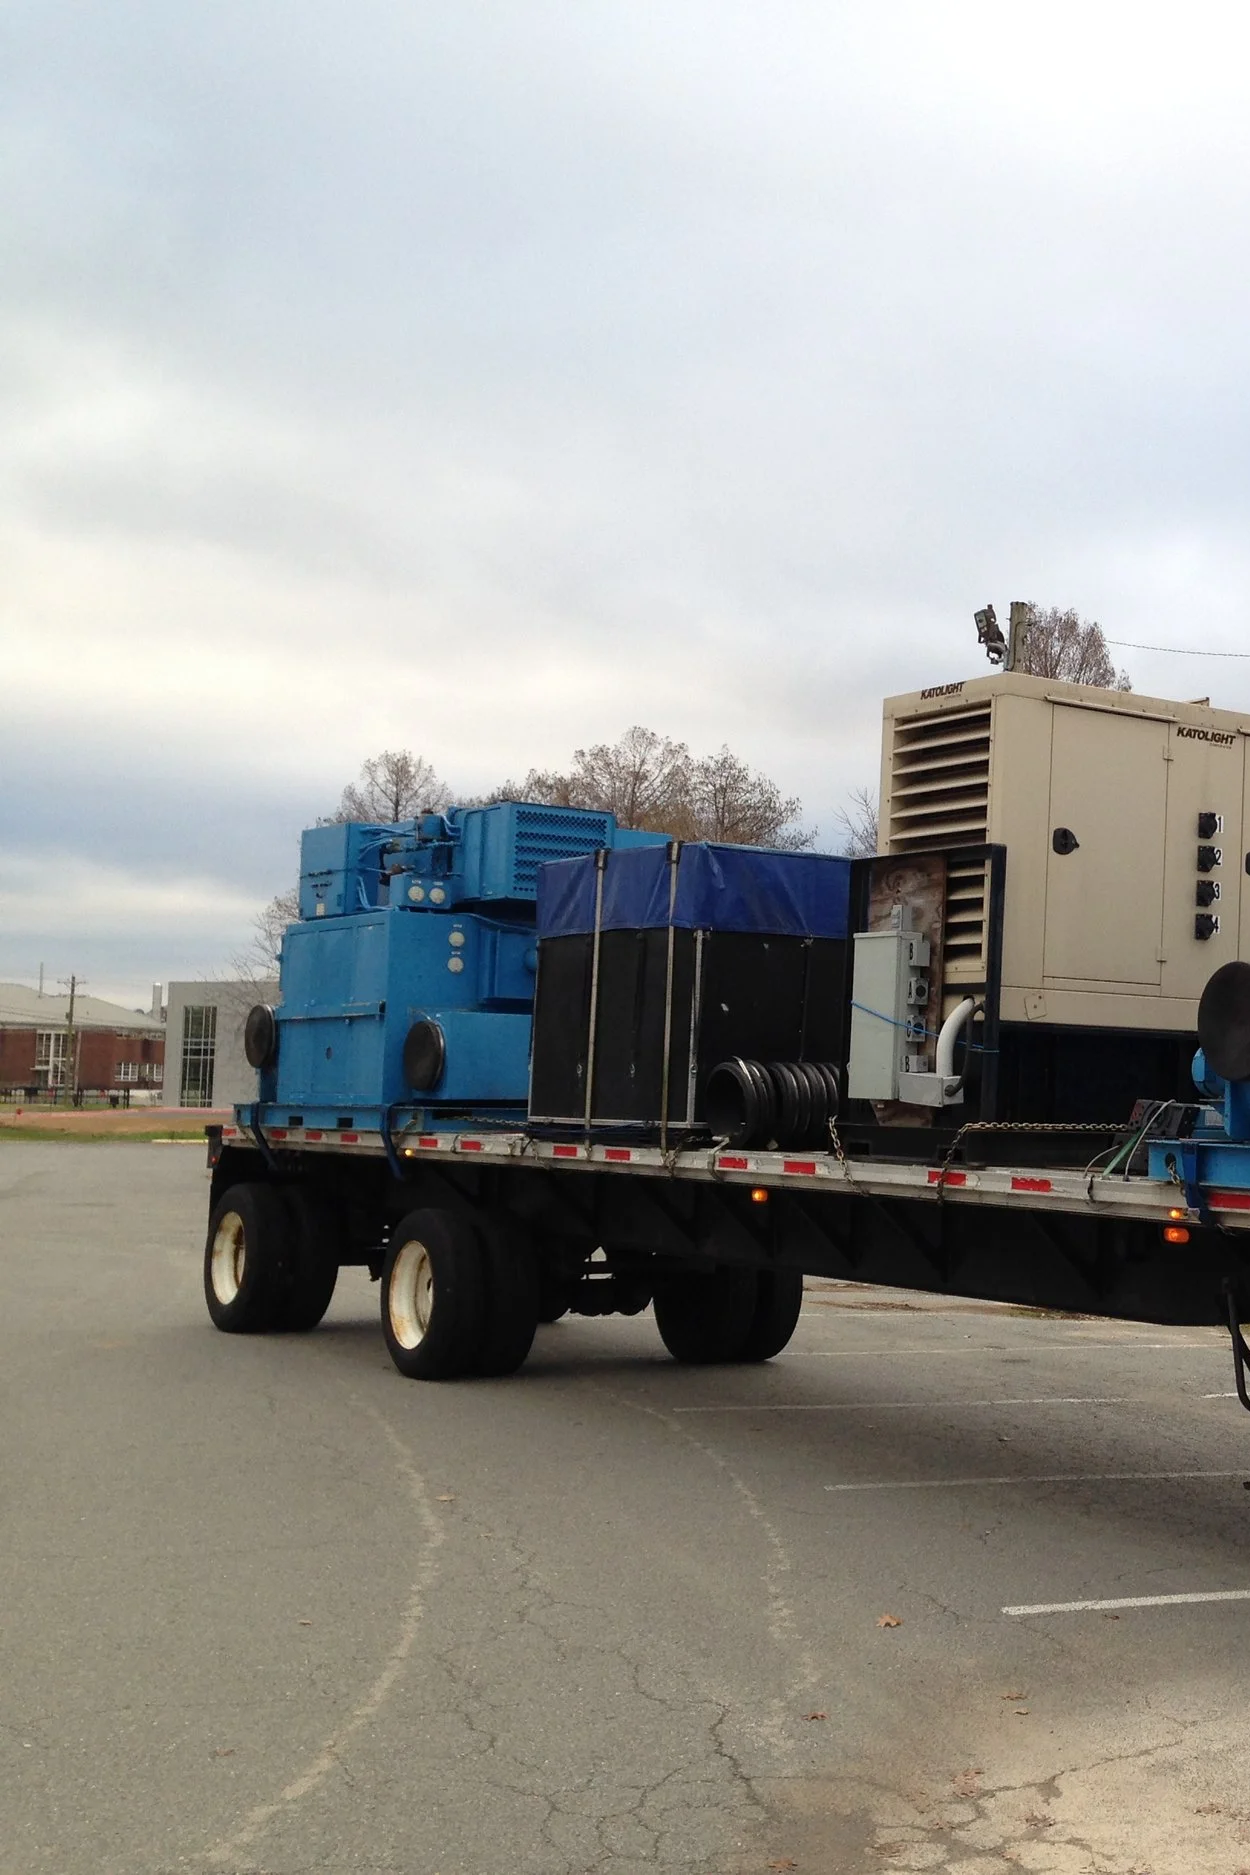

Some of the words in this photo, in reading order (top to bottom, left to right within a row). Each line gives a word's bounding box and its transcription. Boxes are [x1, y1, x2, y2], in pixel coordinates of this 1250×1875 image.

[920, 681, 966, 700] KATOLIGHT
[1176, 726, 1236, 745] KATOLIGHT
[1215, 849, 1221, 866] 2
[1214, 883, 1220, 900] 3
[1212, 915, 1219, 933] 4
[909, 942, 914, 961] B
[908, 980, 912, 999] A
[904, 1055, 910, 1073] B
